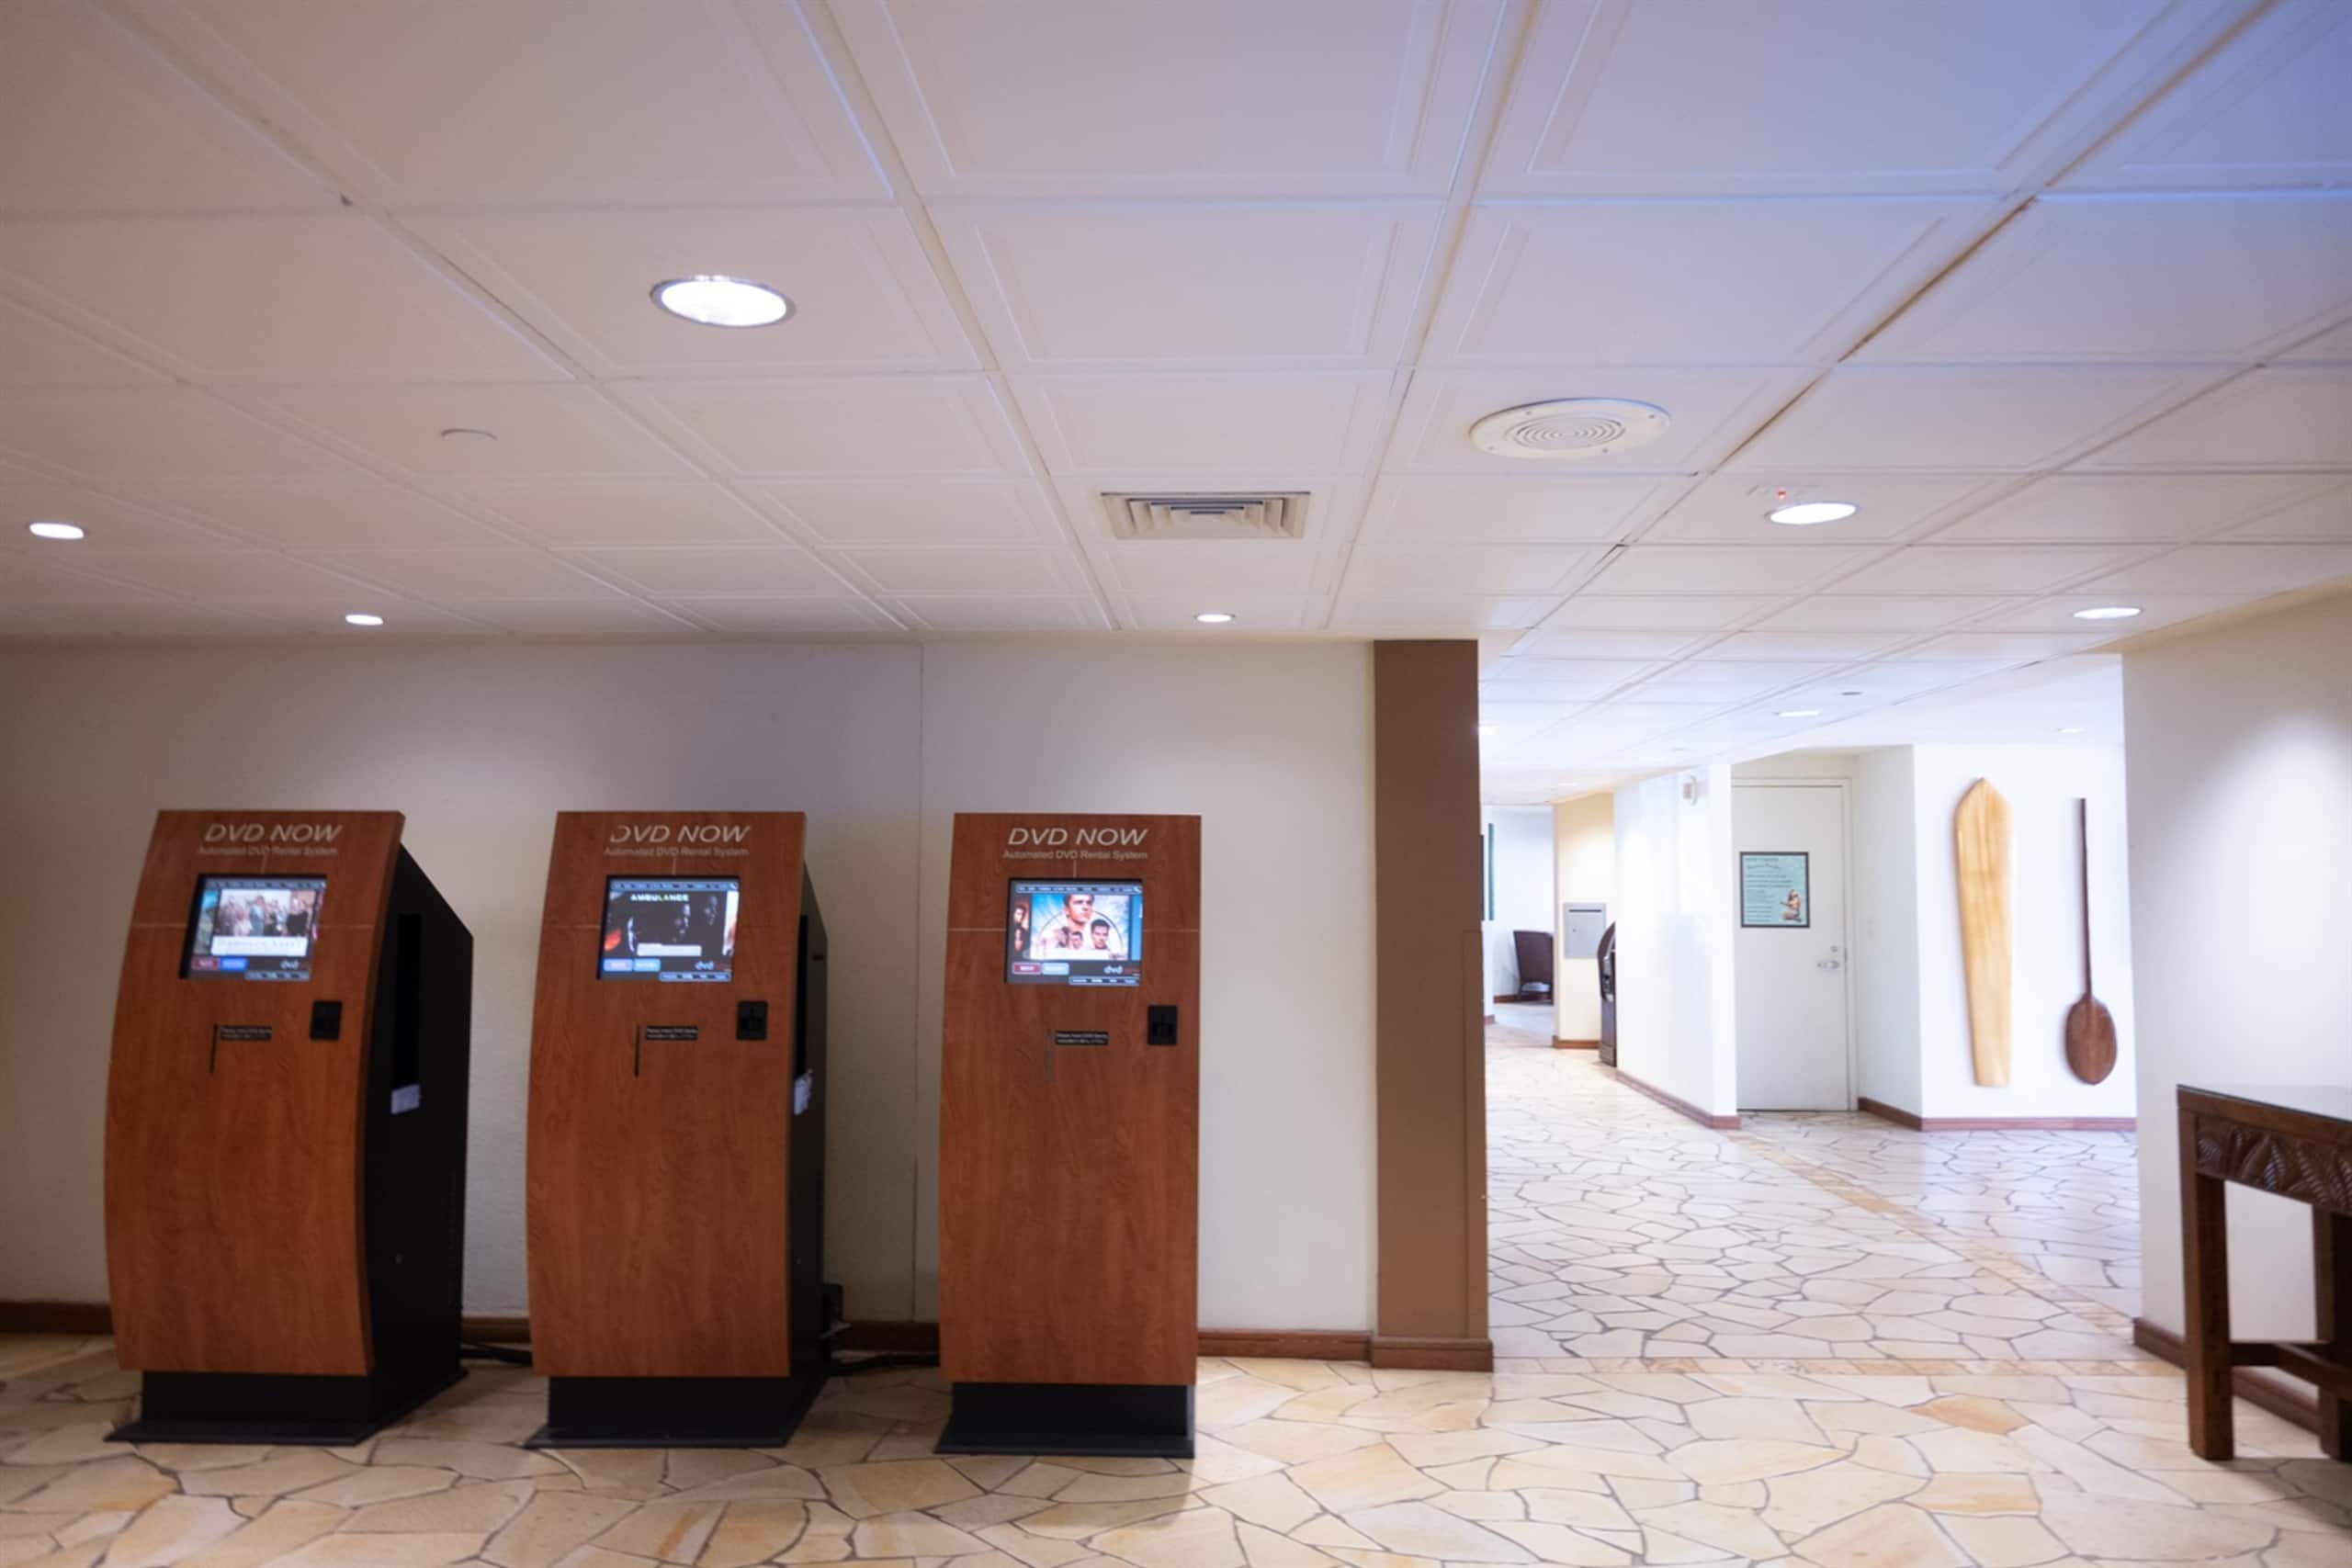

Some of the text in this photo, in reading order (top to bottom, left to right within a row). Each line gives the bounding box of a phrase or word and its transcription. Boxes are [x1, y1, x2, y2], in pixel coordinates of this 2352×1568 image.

[205, 823, 343, 842] DVD NOW
[610, 825, 752, 843] DVD NOW
[1008, 828, 1149, 846] DVD NOW
[603, 847, 654, 856] Automated
[656, 847, 679, 856] DVD
[681, 847, 711, 856] Rental
[1002, 850, 1148, 862] Automated DVD Rental System
[630, 894, 689, 902] AMBULANCE
